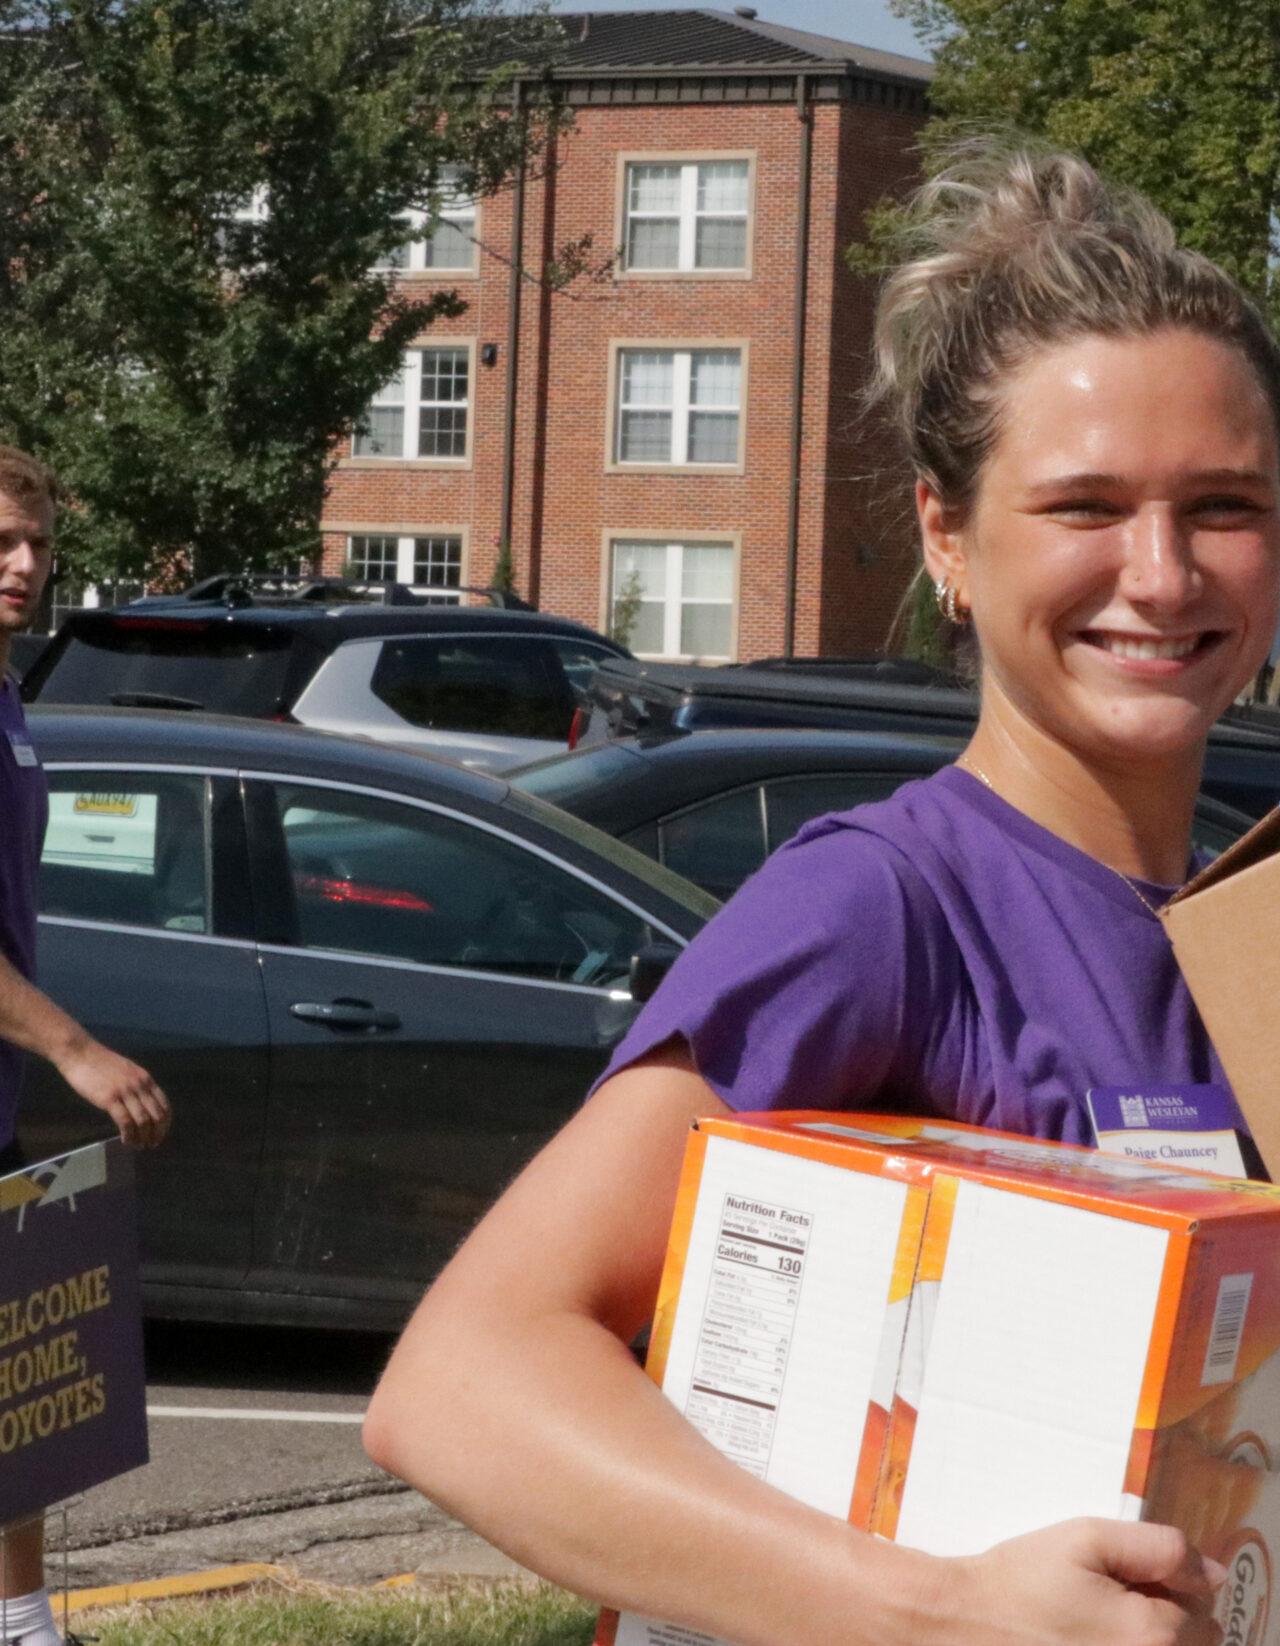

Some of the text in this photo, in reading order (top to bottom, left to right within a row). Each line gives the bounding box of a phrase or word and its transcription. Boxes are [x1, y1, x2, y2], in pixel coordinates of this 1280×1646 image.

[1144, 1096, 1184, 1107] KANSAS
[1147, 1106, 1199, 1117] WESLEYAN
[1124, 1145, 1218, 1161] Paige Chauncey
[726, 1197, 810, 1226] Nutrition Facts
[717, 1243, 759, 1263] Calories
[778, 1256, 802, 1274] 130
[0, 1264, 110, 1347] ELCOME
[0, 1373, 105, 1452] OYOTES
